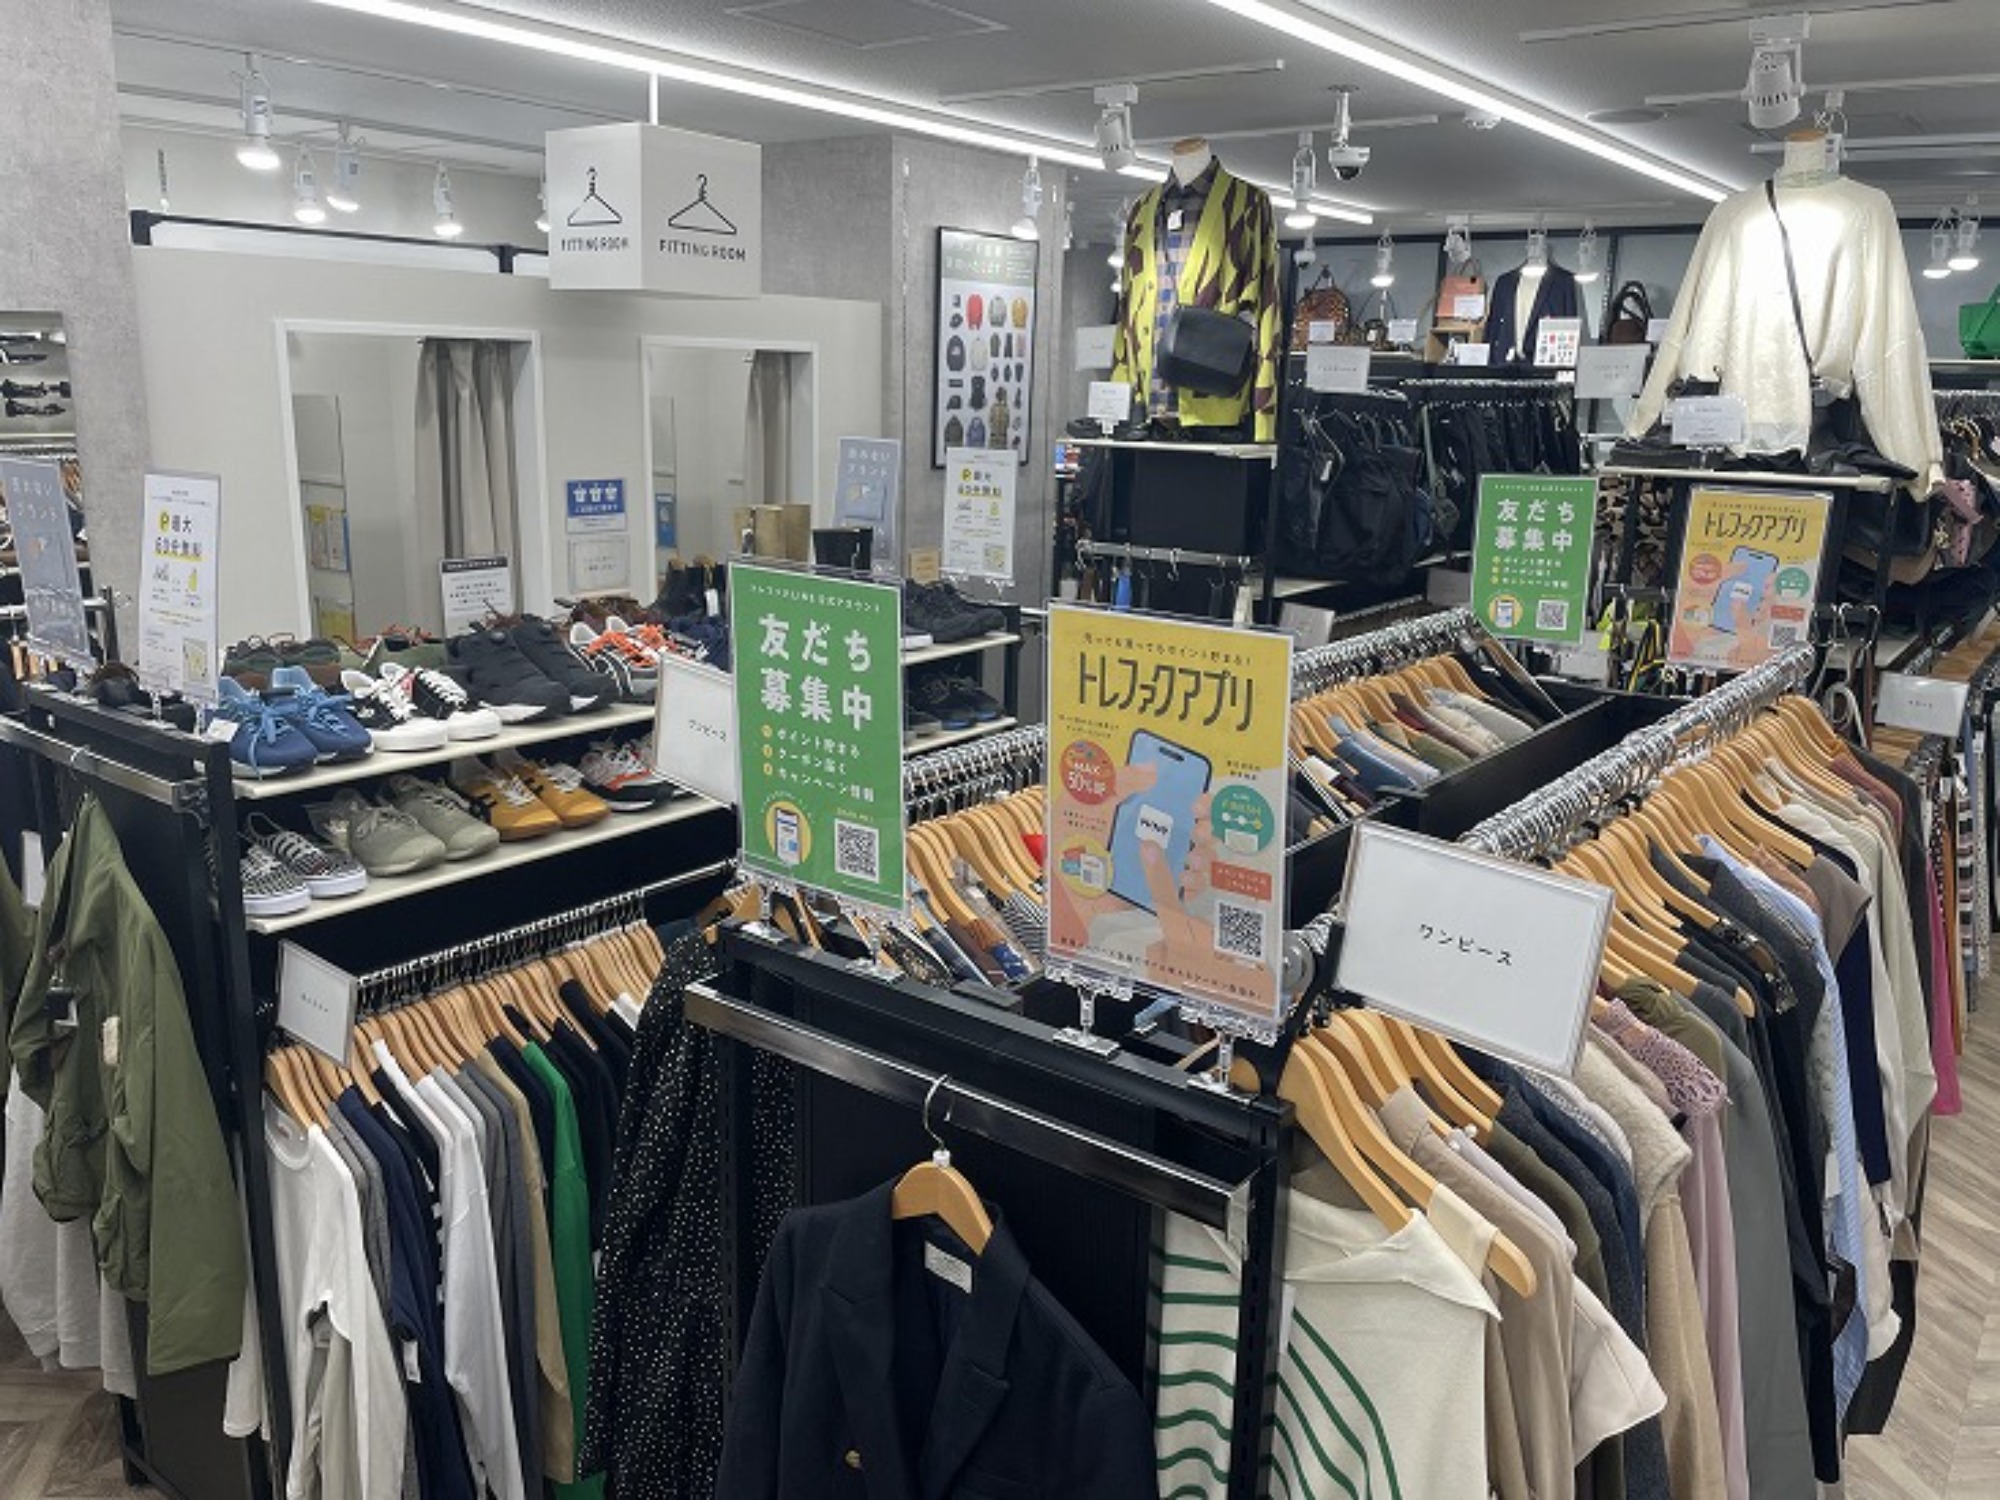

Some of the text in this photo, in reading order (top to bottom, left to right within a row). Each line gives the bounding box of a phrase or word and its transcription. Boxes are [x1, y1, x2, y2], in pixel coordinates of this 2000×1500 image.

[561, 237, 598, 252] FITTING
[659, 239, 746, 262] FITTING ROOM
[1496, 499, 1575, 524] 友だち
[1494, 526, 1573, 554] 募集中
[758, 613, 871, 673] 友だち
[760, 667, 872, 731] 募集中
[1079, 652, 1253, 732] トレファクアプリ
[689, 719, 727, 742] ワンピース
[1419, 924, 1513, 966] ワンピース
